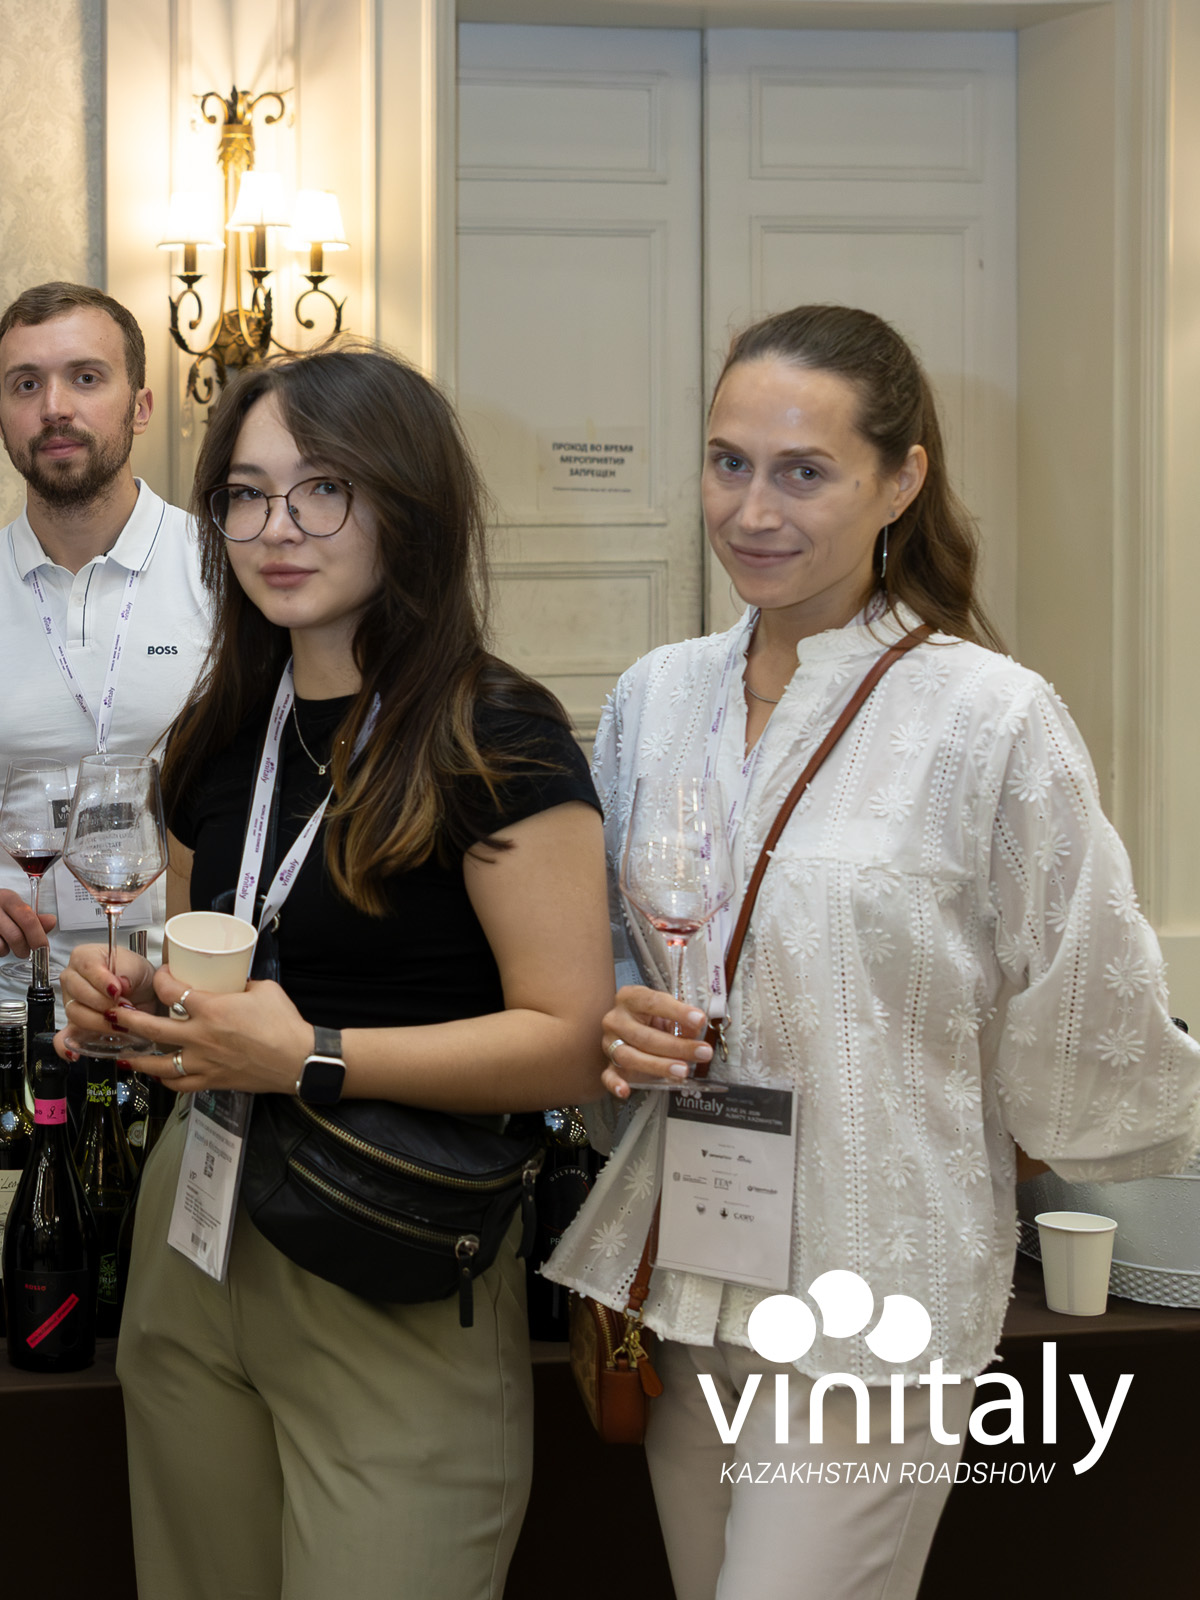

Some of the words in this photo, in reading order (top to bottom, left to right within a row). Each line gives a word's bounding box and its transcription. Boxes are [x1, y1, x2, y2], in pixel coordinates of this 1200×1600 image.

[552, 442, 588, 453] ПРОХОД
[590, 443, 602, 452] ВО
[604, 444, 633, 453] ВРЕМЯ
[124, 602, 133, 620] vinitaly
[147, 646, 178, 655] BOSS
[107, 687, 115, 708] vinitaly
[261, 757, 271, 783] vinitaly
[282, 858, 299, 886] vinitaly
[239, 872, 250, 900] vinitaly
[675, 1095, 724, 1115] vinitaly
